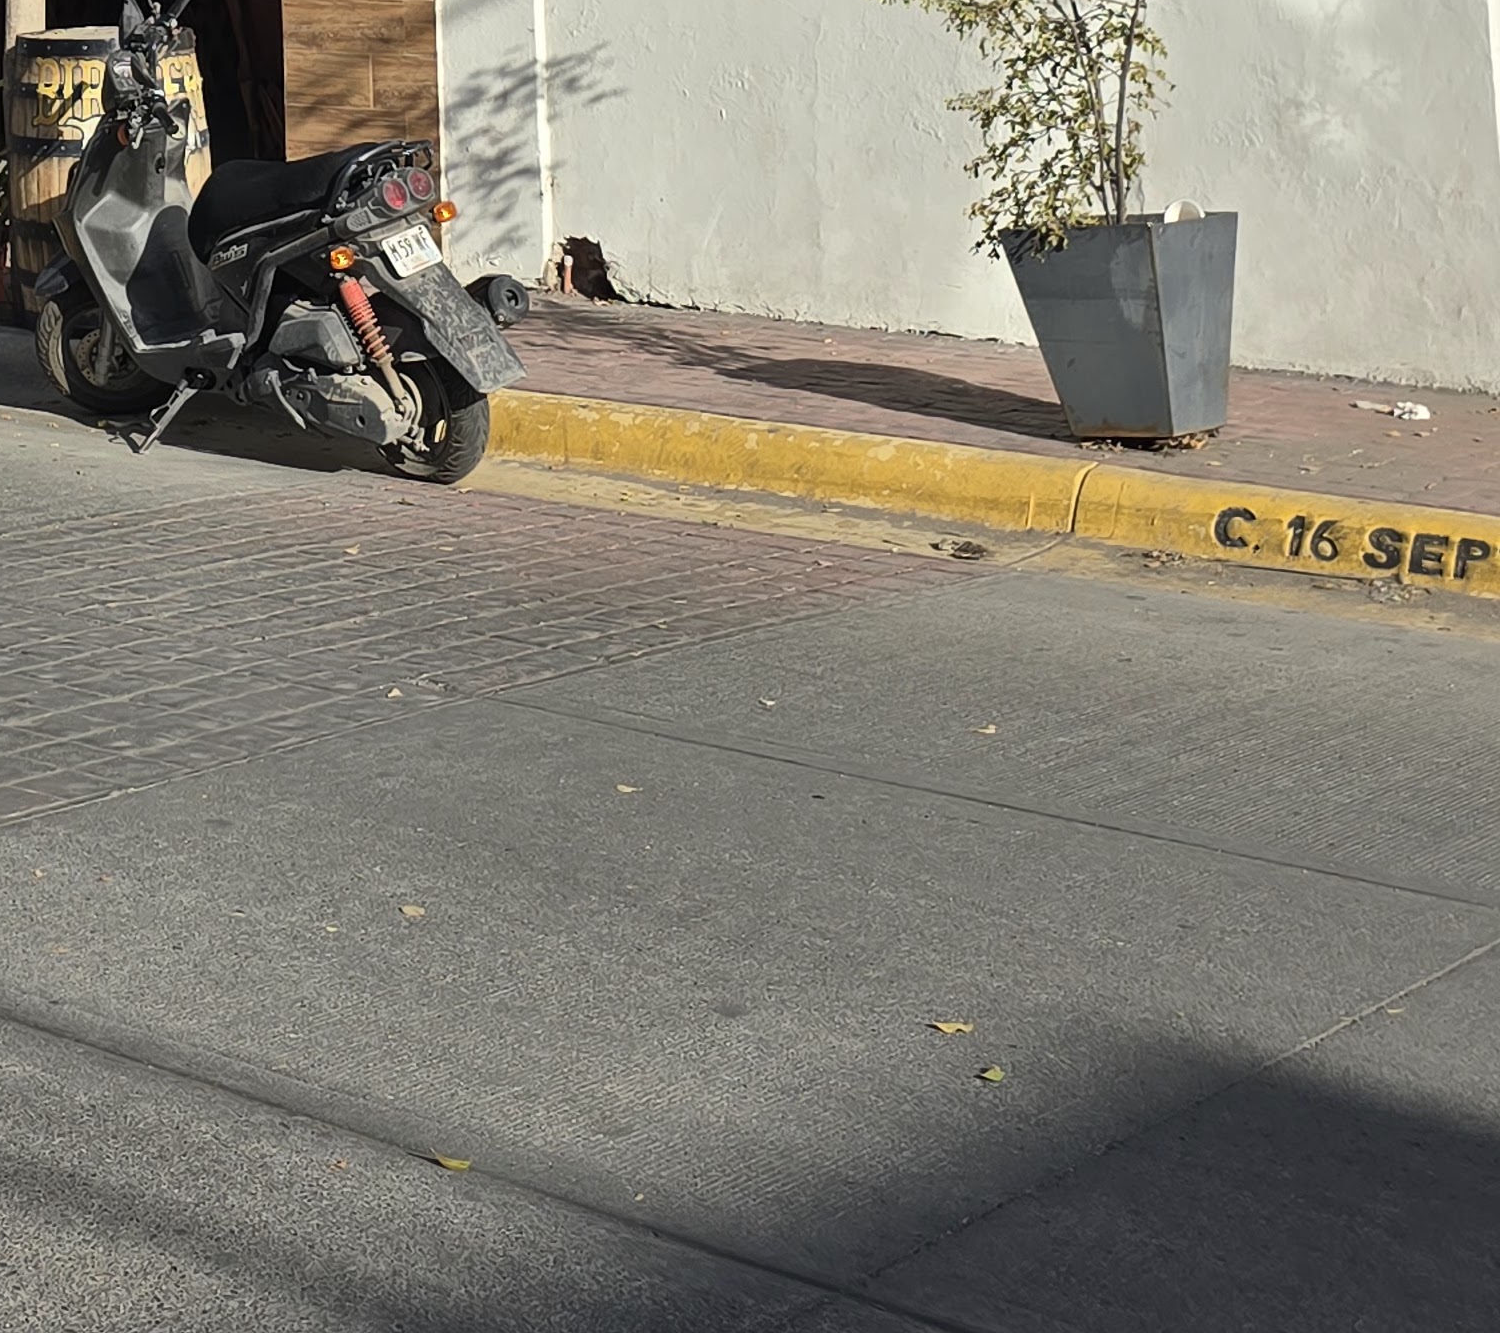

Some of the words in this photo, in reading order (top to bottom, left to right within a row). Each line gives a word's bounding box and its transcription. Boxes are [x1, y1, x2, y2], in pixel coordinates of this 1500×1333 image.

[1213, 506, 1260, 554] C.
[1286, 514, 1339, 562] 16
[1361, 526, 1492, 580] SEP
